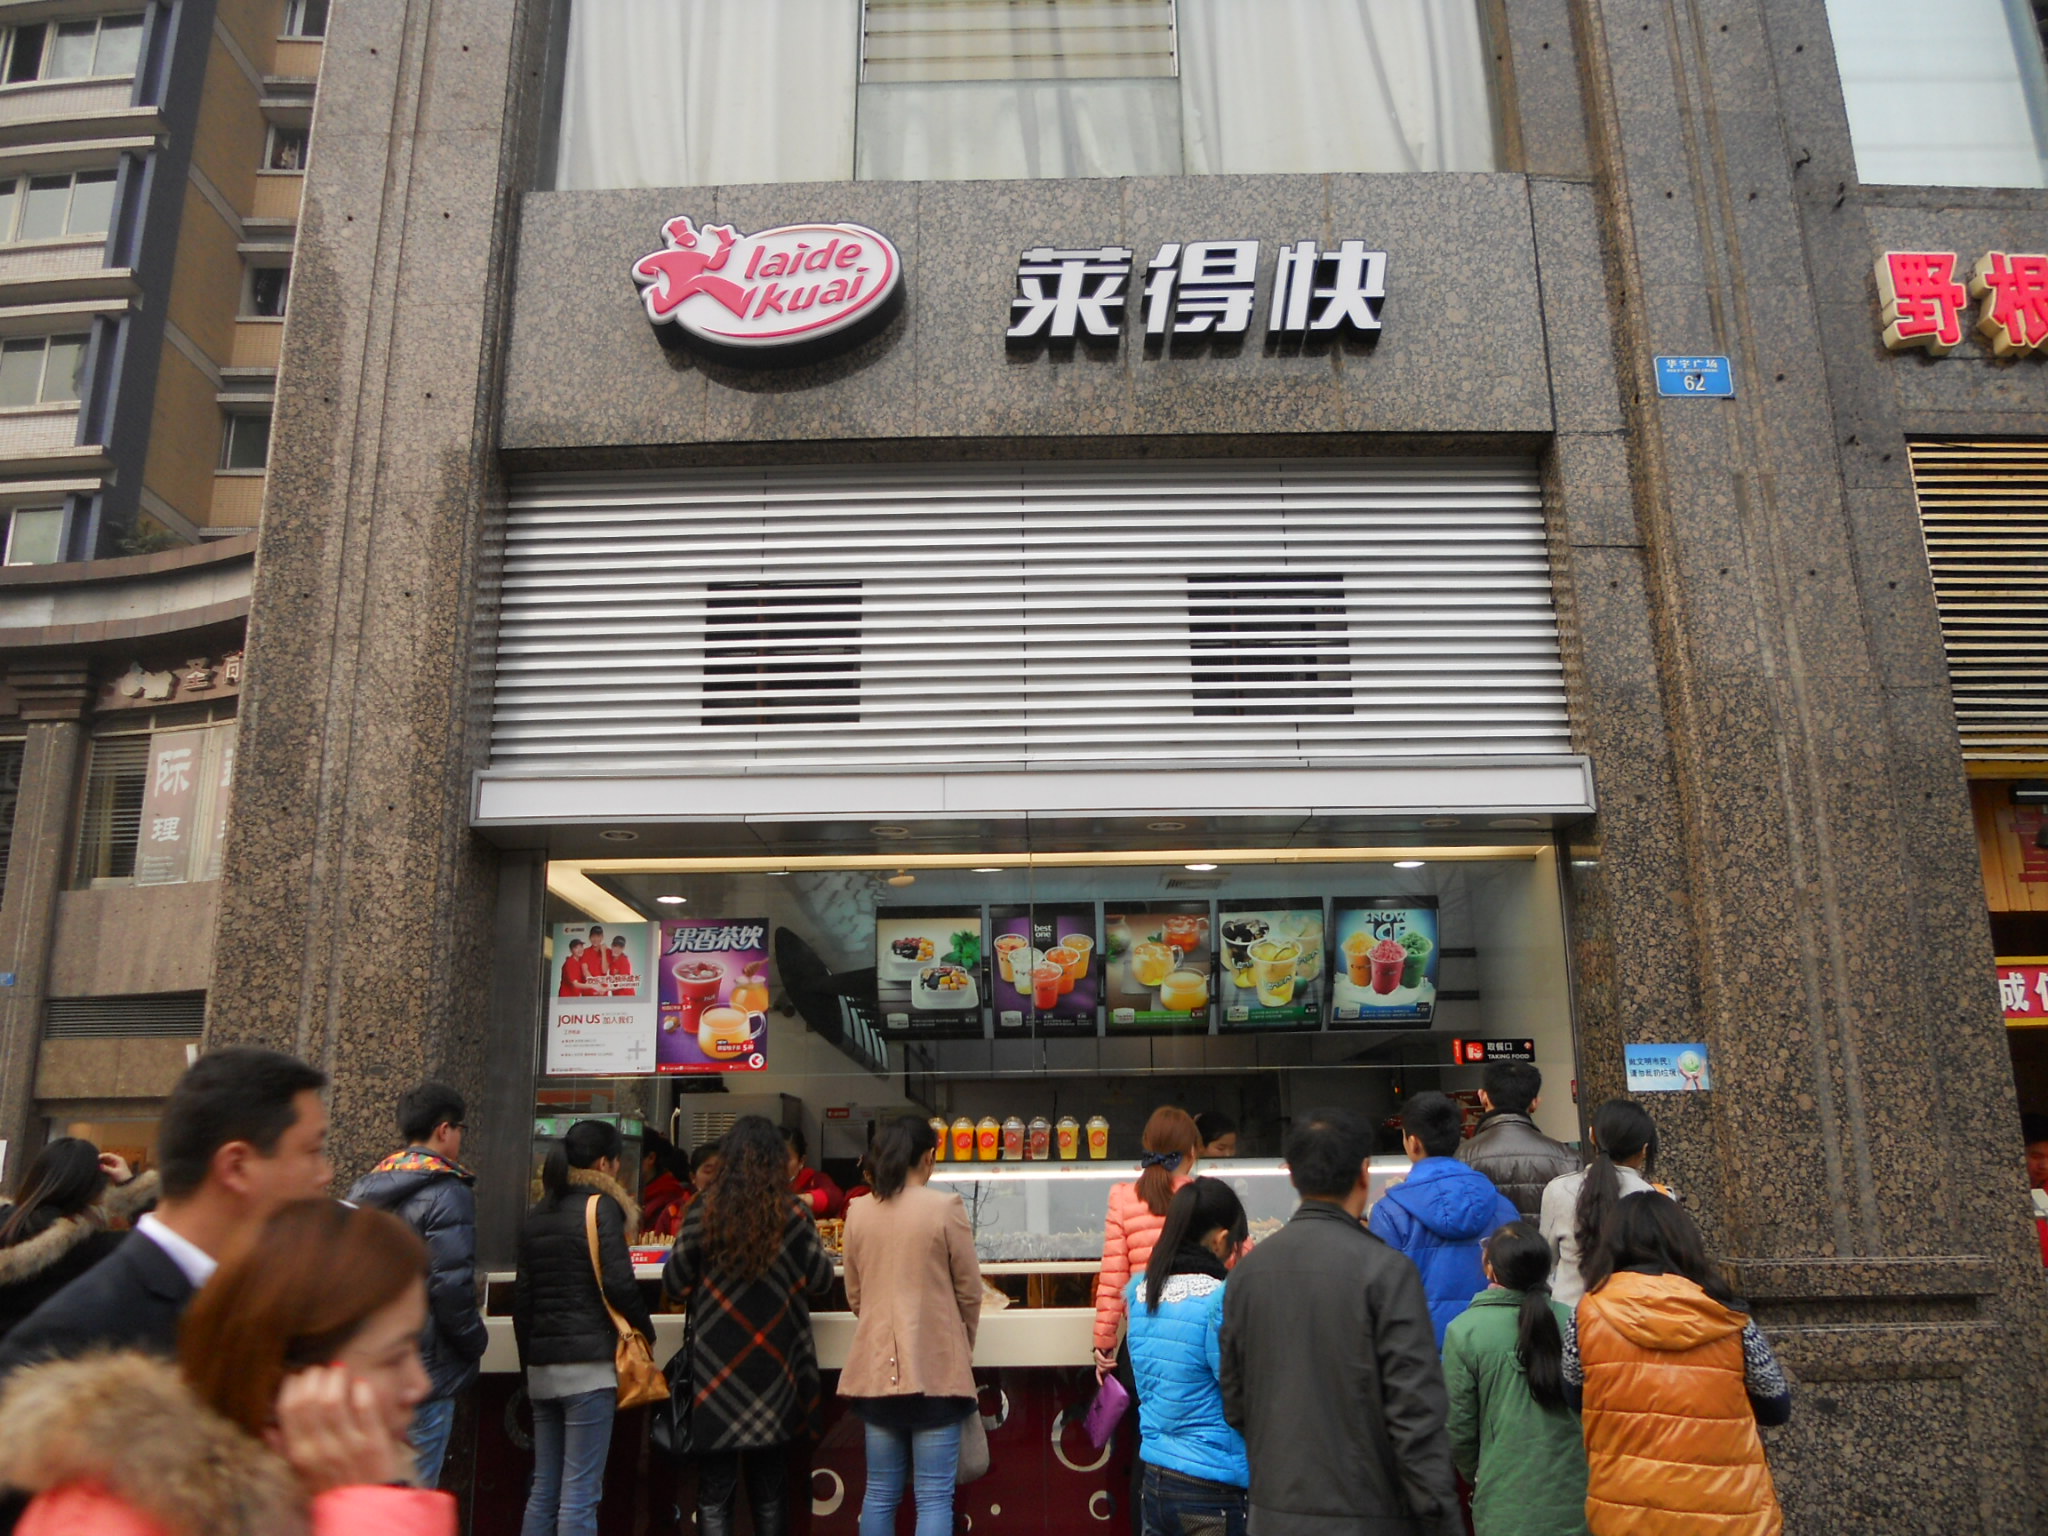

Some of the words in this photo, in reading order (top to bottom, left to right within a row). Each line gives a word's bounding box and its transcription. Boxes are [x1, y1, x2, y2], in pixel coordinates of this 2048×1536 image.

[745, 238, 863, 280] laide
[752, 267, 870, 319] kuai
[1005, 239, 1388, 337] 莱得快
[1684, 375, 1706, 391] 62
[665, 925, 764, 954] 果香茶饮
[557, 1014, 583, 1028] JOIN
[586, 1014, 600, 1024] US
